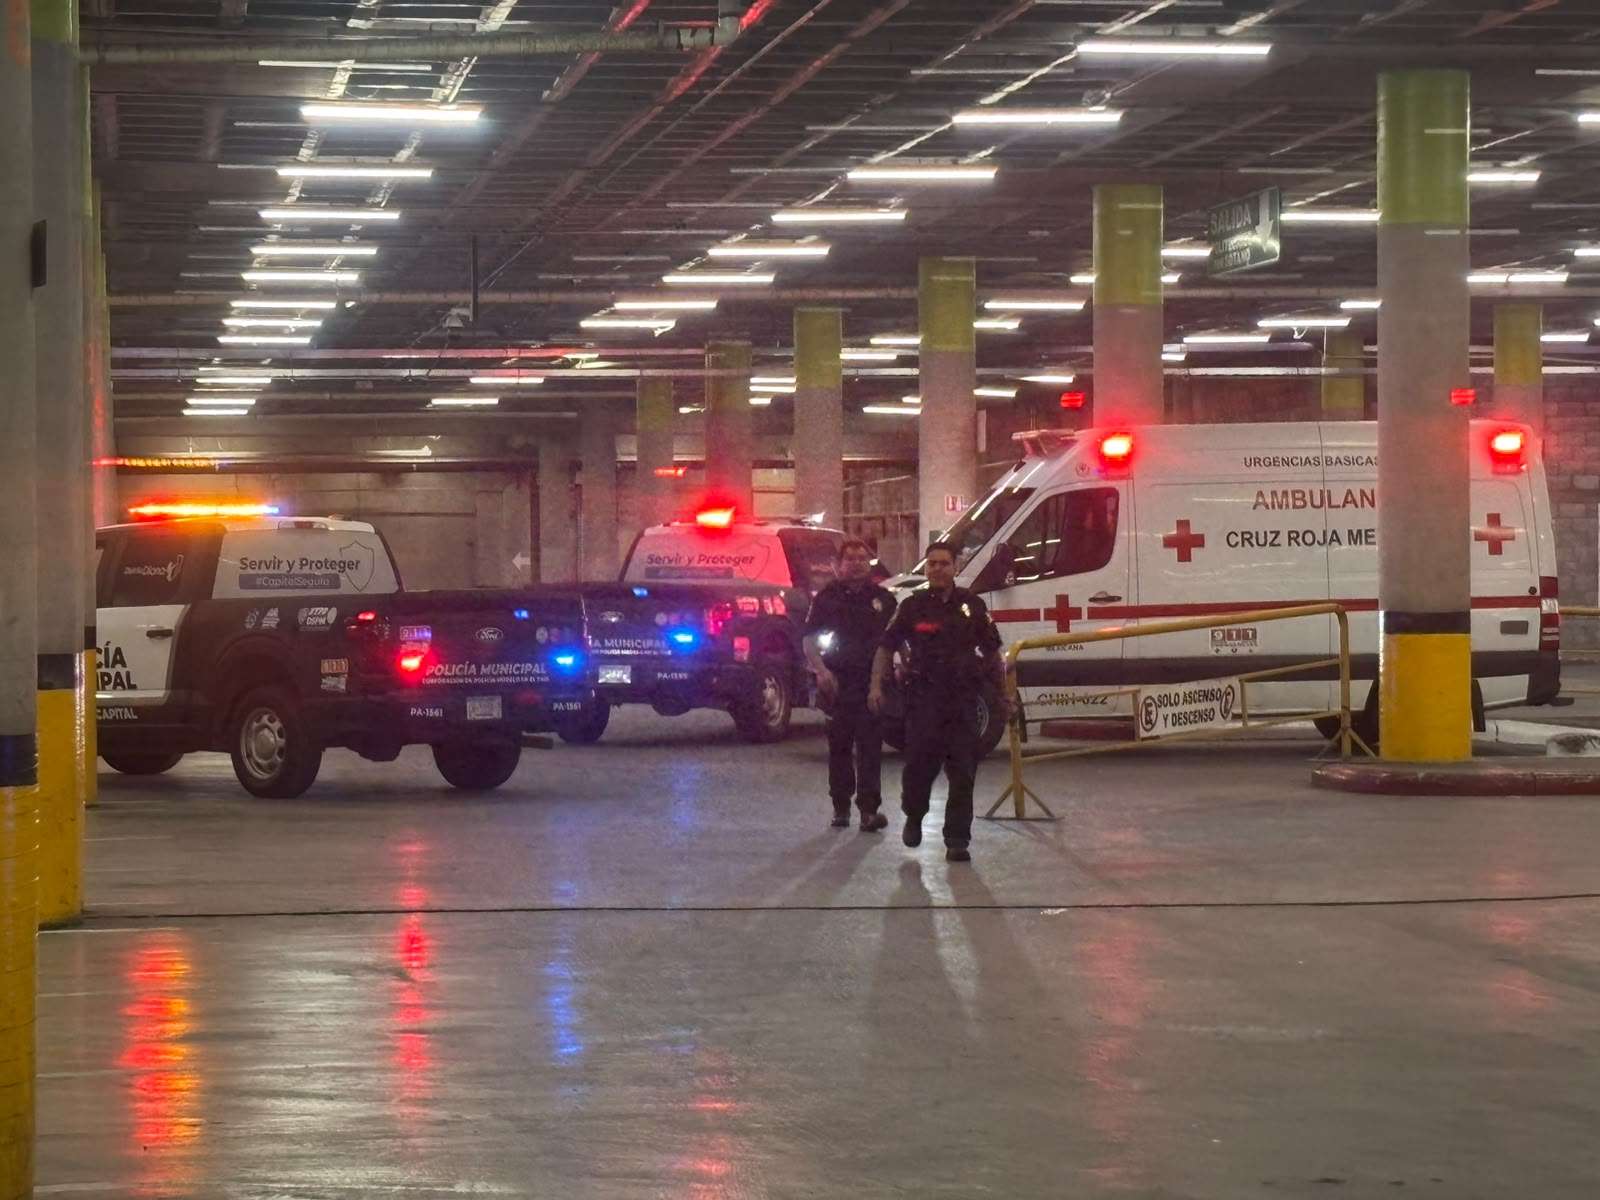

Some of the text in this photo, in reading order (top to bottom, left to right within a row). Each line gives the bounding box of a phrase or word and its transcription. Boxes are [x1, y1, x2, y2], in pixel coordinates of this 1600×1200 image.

[1209, 203, 1252, 234] SALIDA
[1244, 455, 1321, 468] URGENCIAS
[1252, 488, 1376, 511] AMBULAN
[1226, 528, 1376, 548] CRUZ ROJA ME
[239, 556, 361, 574] Servir y Proteger
[647, 553, 682, 565] Servir
[697, 553, 756, 567] Proteger
[426, 661, 547, 677] POLICÍA MUNICIPAL
[1157, 687, 1222, 708] SOLO ASCENSO
[1163, 708, 1216, 728] Y DESCENSO
